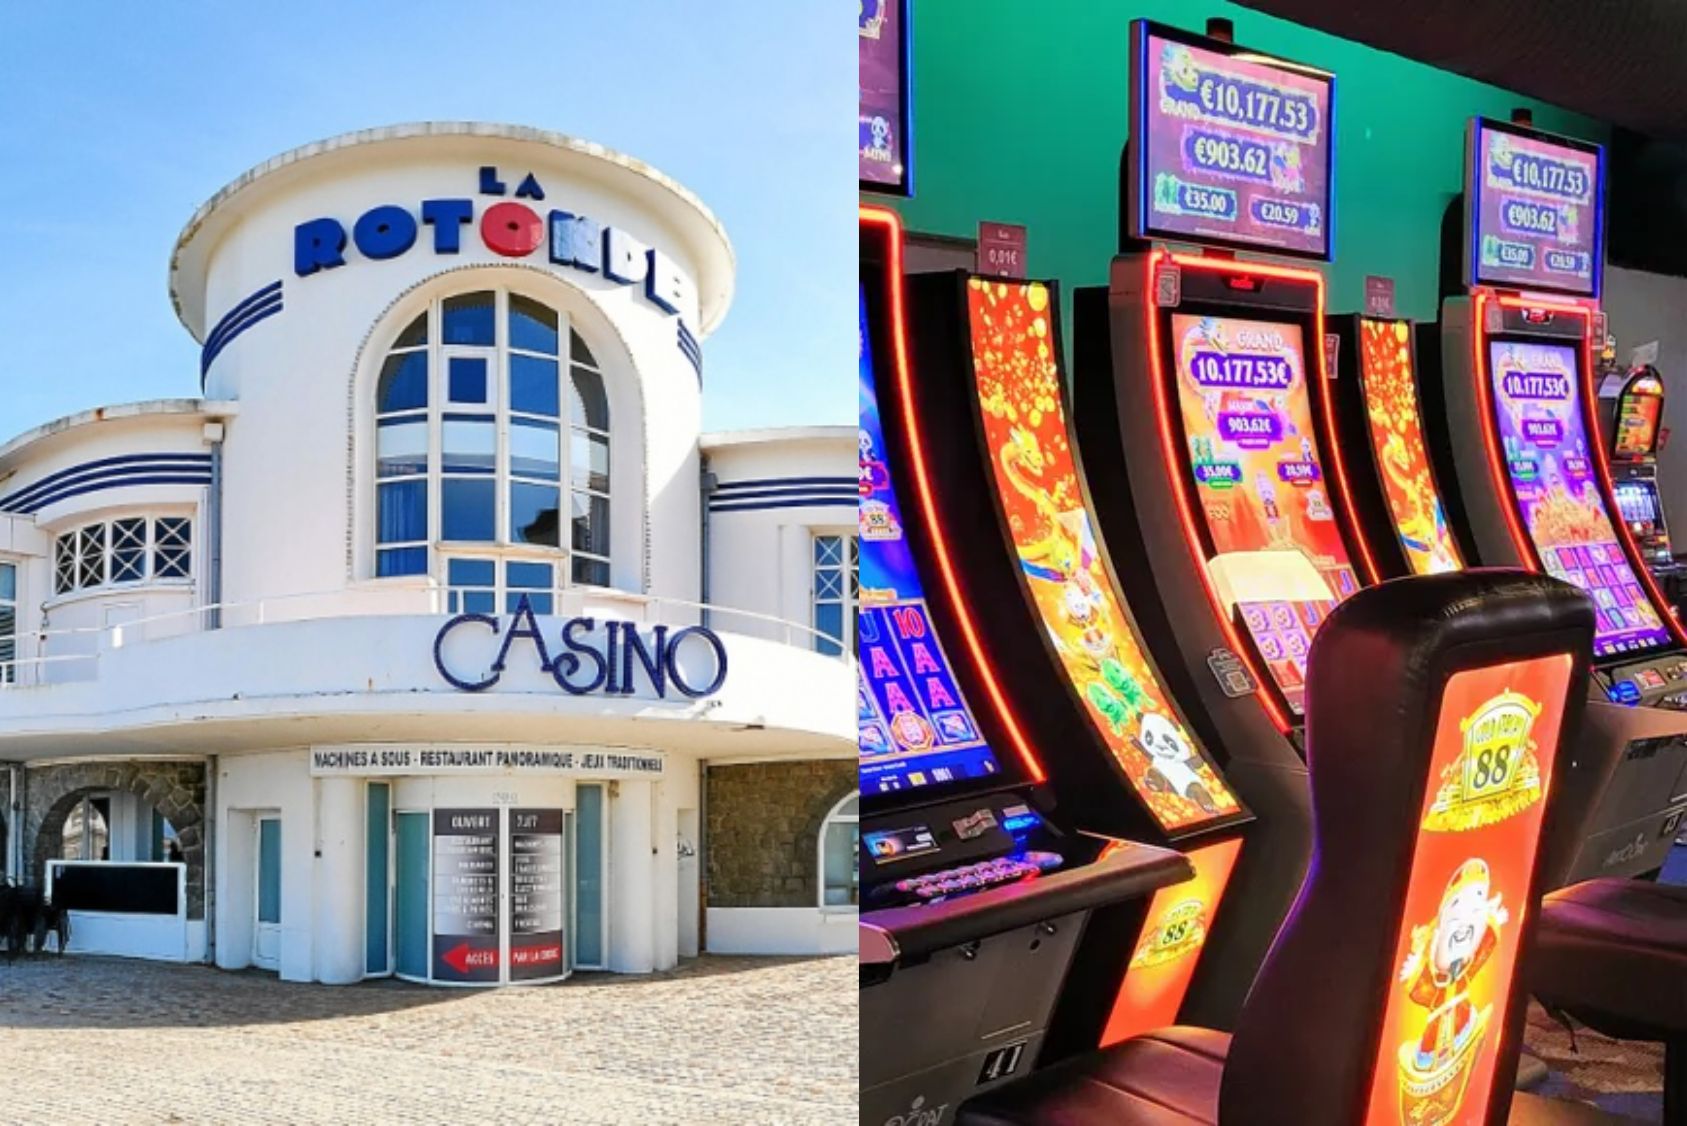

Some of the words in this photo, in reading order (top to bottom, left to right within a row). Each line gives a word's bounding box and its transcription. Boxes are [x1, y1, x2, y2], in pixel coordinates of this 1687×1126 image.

[1200, 78, 1308, 131] €10,177.53
[1194, 136, 1267, 176] €903.62
[479, 166, 545, 200] LA
[1513, 158, 1584, 194] €10,177.53
[1184, 189, 1227, 213] €35.00
[1508, 204, 1556, 231] €903.62
[294, 198, 687, 316] ROTONDE
[893, 607, 925, 639] 10
[433, 592, 728, 699] CASINO
[869, 646, 900, 679] A
[911, 642, 942, 674] A
[927, 677, 956, 709] A
[313, 751, 368, 768] MACHINES
[370, 751, 379, 767] A
[381, 751, 410, 767] SOUS
[420, 751, 494, 768] RESTAURANT
[496, 751, 573, 768] PANORAMIQUE
[1473, 744, 1511, 790] 88
[451, 815, 490, 829] OUVERT
[1162, 920, 1188, 945] 88
